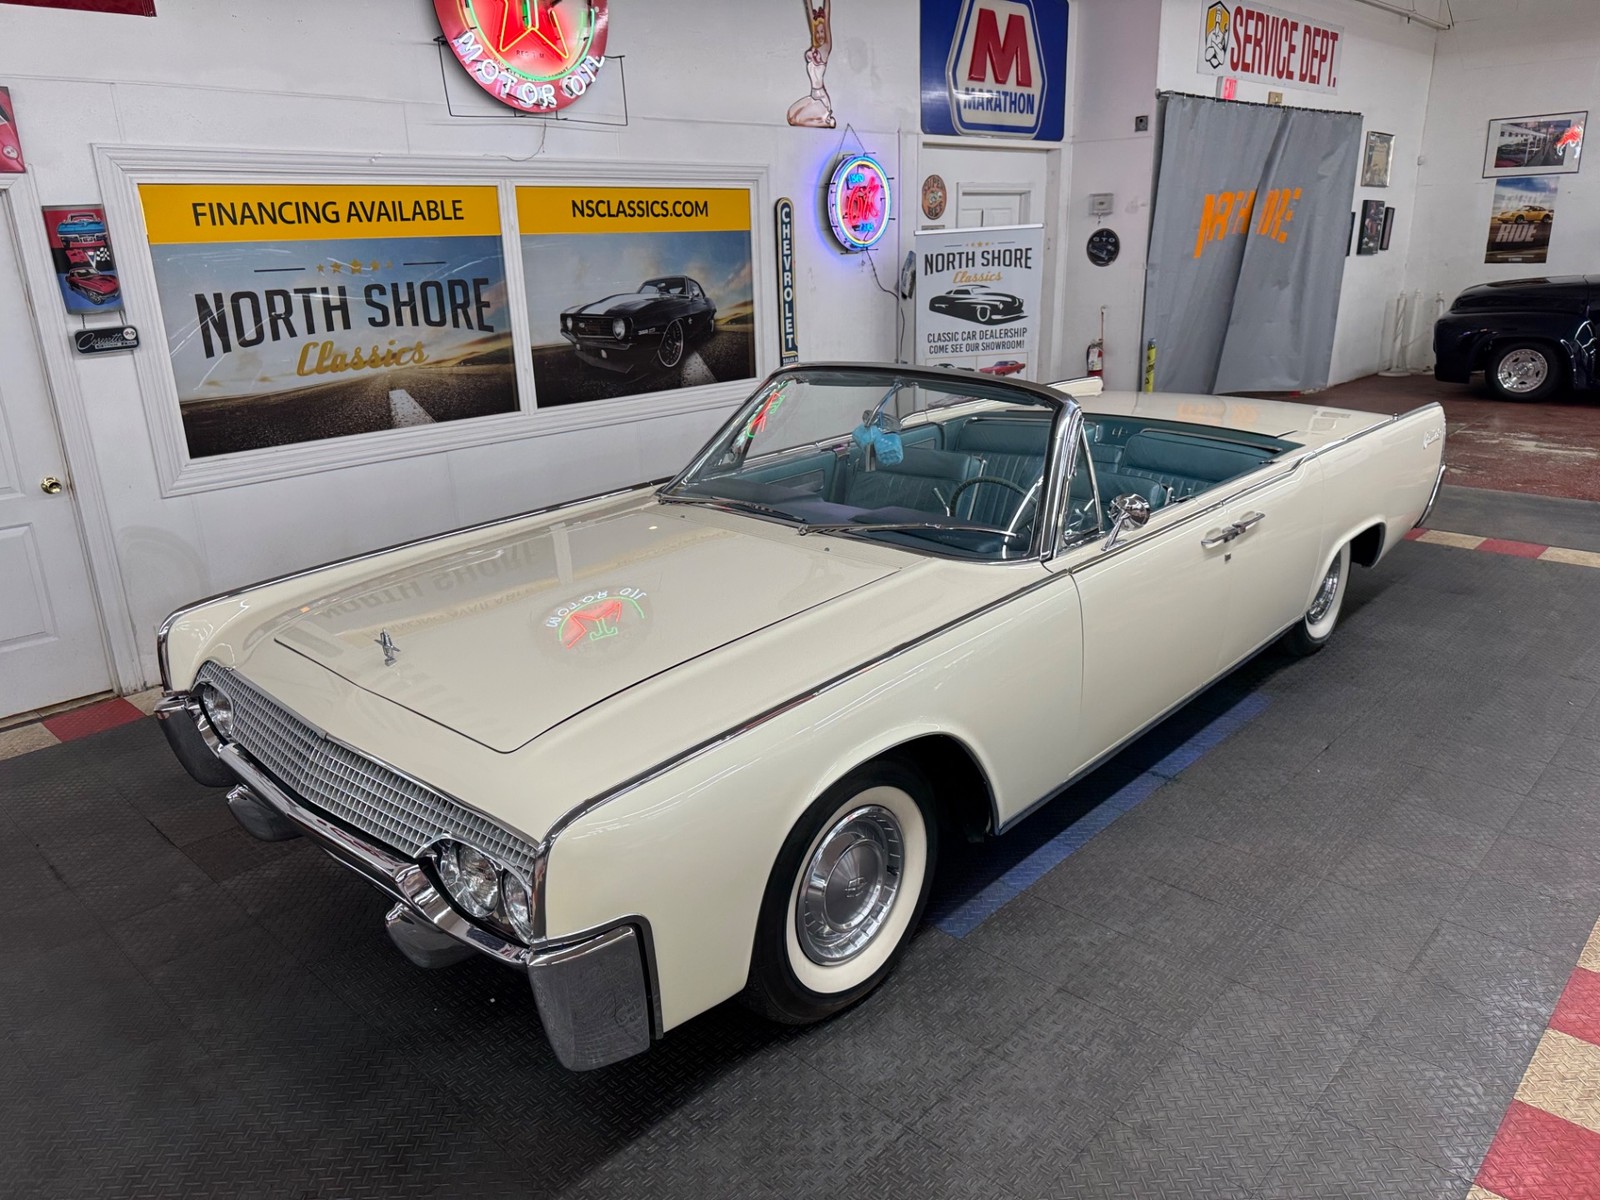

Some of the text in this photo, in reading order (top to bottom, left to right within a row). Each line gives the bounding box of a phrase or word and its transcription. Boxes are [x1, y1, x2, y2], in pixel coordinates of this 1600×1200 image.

[968, 8, 1032, 88] M
[1230, 6, 1339, 88] SERVICE DEPT.
[456, 30, 605, 109] MOTOR OIL
[963, 87, 1035, 115] MARATHON
[192, 199, 464, 227] FINANCING AVAILABLE
[571, 199, 709, 218] NSCLASSICS.COM
[1495, 223, 1537, 243] RIDE
[924, 247, 1033, 276] NORTH SHORE
[781, 207, 794, 349] CHEVROLET
[952, 271, 1003, 284] Classics
[195, 278, 495, 359] NORTH SHORE
[927, 327, 1028, 343] CLASSIC CAR DEALERSHIP
[928, 339, 1025, 355] COME SEE OUR SHOWROOM!
[296, 340, 430, 377] Classics
